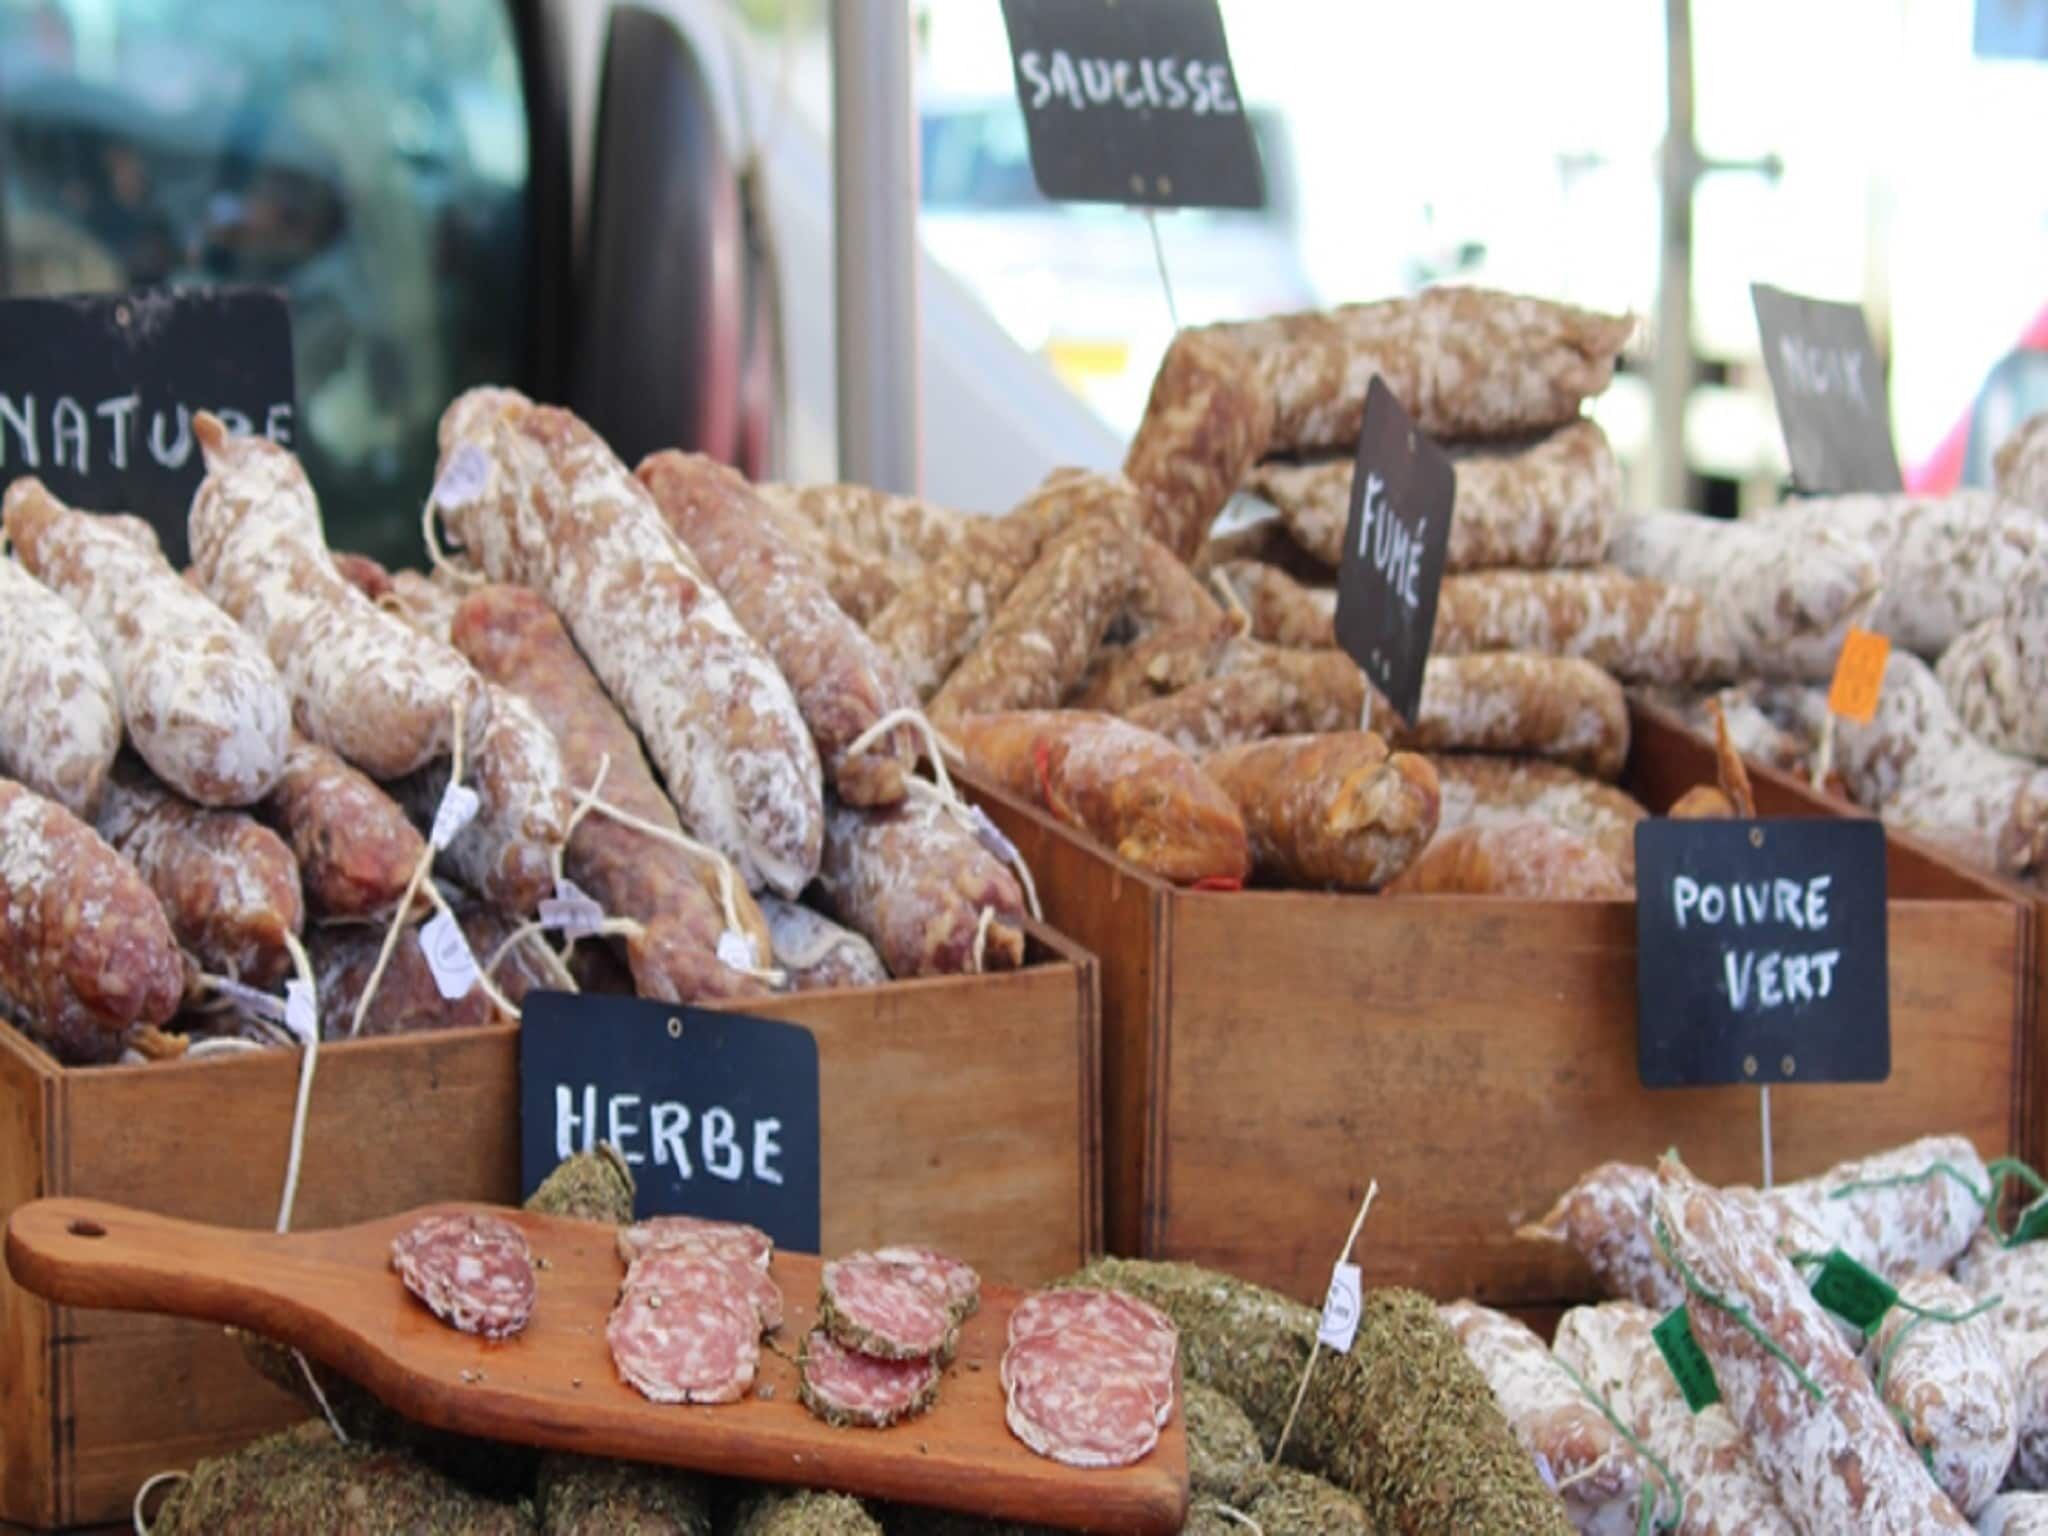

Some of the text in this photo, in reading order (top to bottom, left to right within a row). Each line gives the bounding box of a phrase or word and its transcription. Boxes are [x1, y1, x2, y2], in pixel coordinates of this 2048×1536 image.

[1019, 49, 1238, 115] SAUCISSE
[1358, 472, 1428, 608] FUMÉ
[1672, 874, 1833, 931] POIVRE
[1723, 950, 1841, 1011] VERT
[555, 1084, 784, 1184] HERBE
